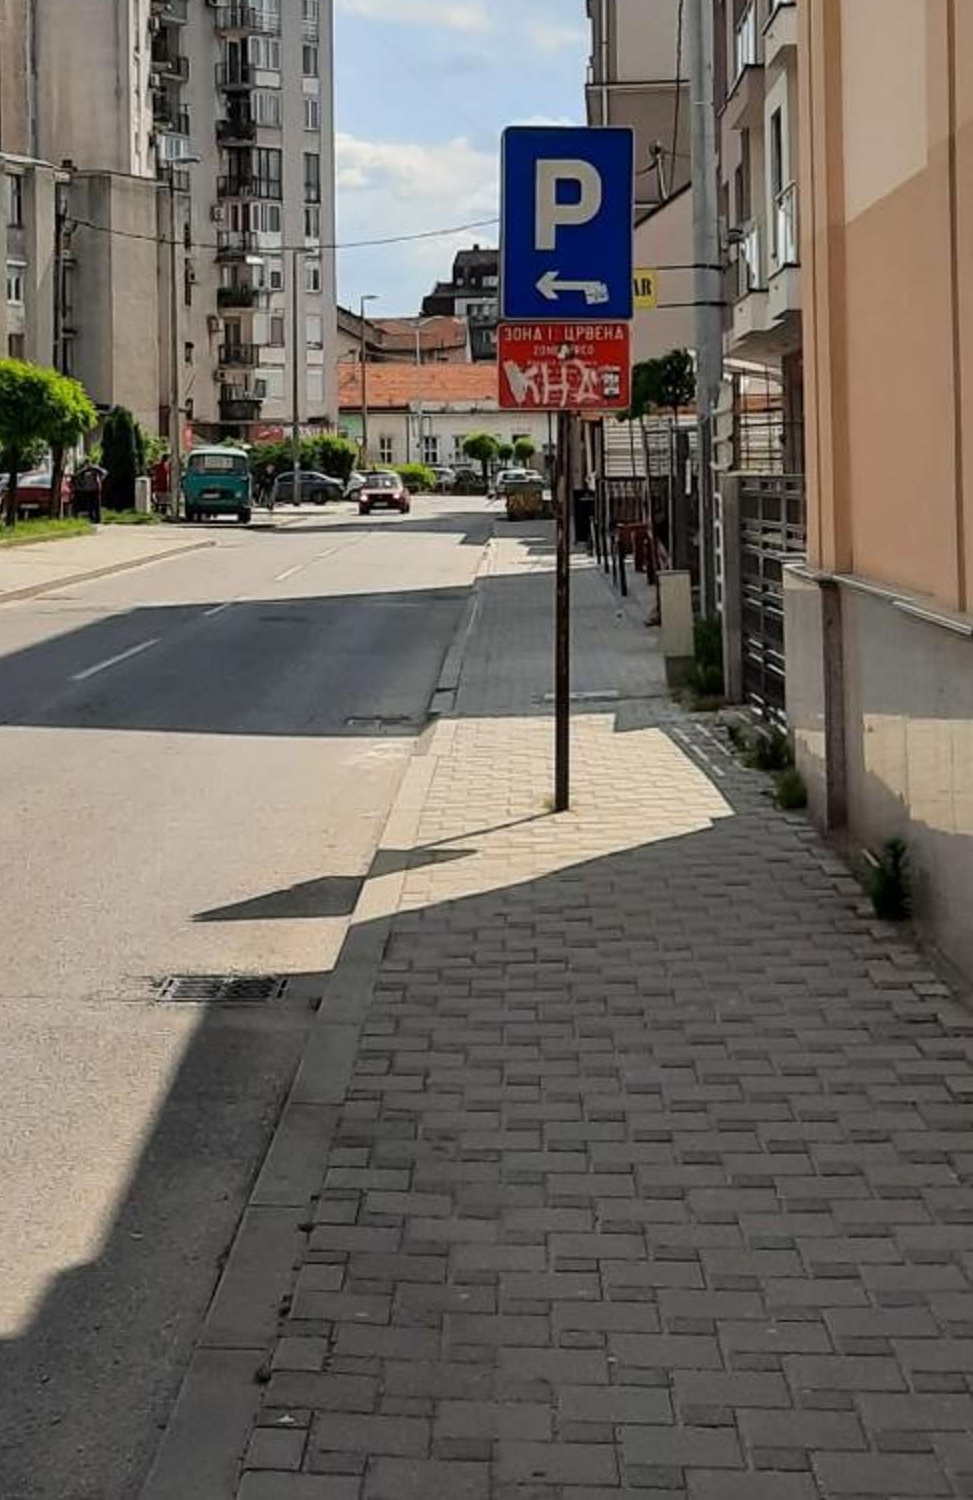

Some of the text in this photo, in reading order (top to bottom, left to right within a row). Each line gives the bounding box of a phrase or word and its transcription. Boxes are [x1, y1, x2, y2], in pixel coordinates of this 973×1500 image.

[535, 159, 602, 250] P
[504, 326, 542, 341] ЗОНА
[564, 326, 624, 341] ЦРВЕНА
